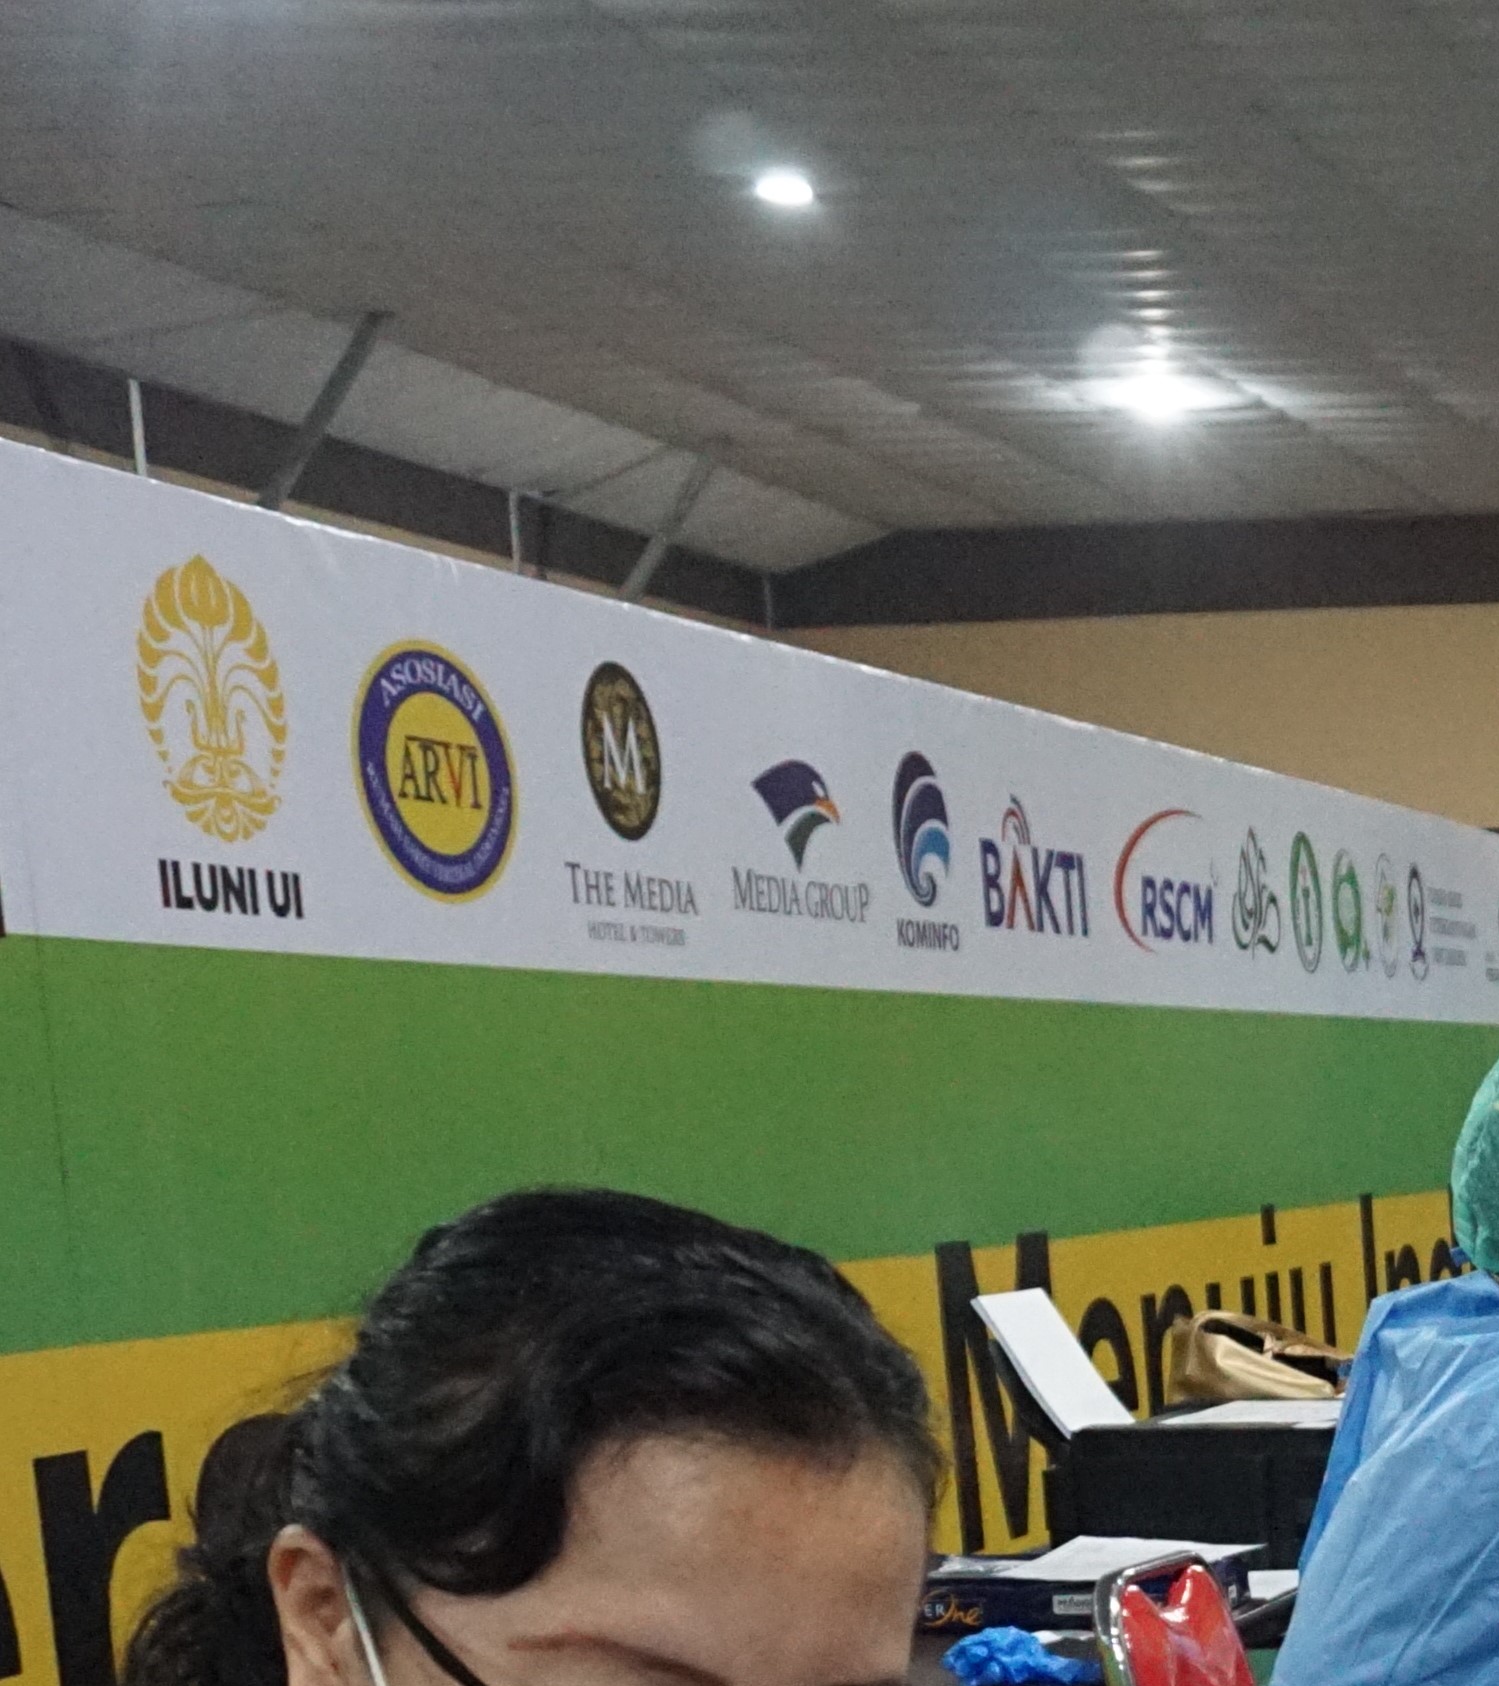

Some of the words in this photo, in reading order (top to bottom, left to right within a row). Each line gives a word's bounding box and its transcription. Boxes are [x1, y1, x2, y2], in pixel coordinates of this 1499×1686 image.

[379, 657, 487, 722] ASOSIASI
[398, 735, 483, 810] ARVI
[601, 711, 646, 794] M
[158, 858, 261, 917] ILUNI
[266, 869, 304, 920] UI
[565, 862, 616, 907] THE
[624, 869, 699, 916] MEDIA
[732, 866, 803, 916] MEDIA
[805, 880, 870, 923] GROUP
[979, 838, 1089, 937] BAKTI
[1141, 876, 1214, 944] RSCM
[897, 918, 960, 952] KOMINFO
